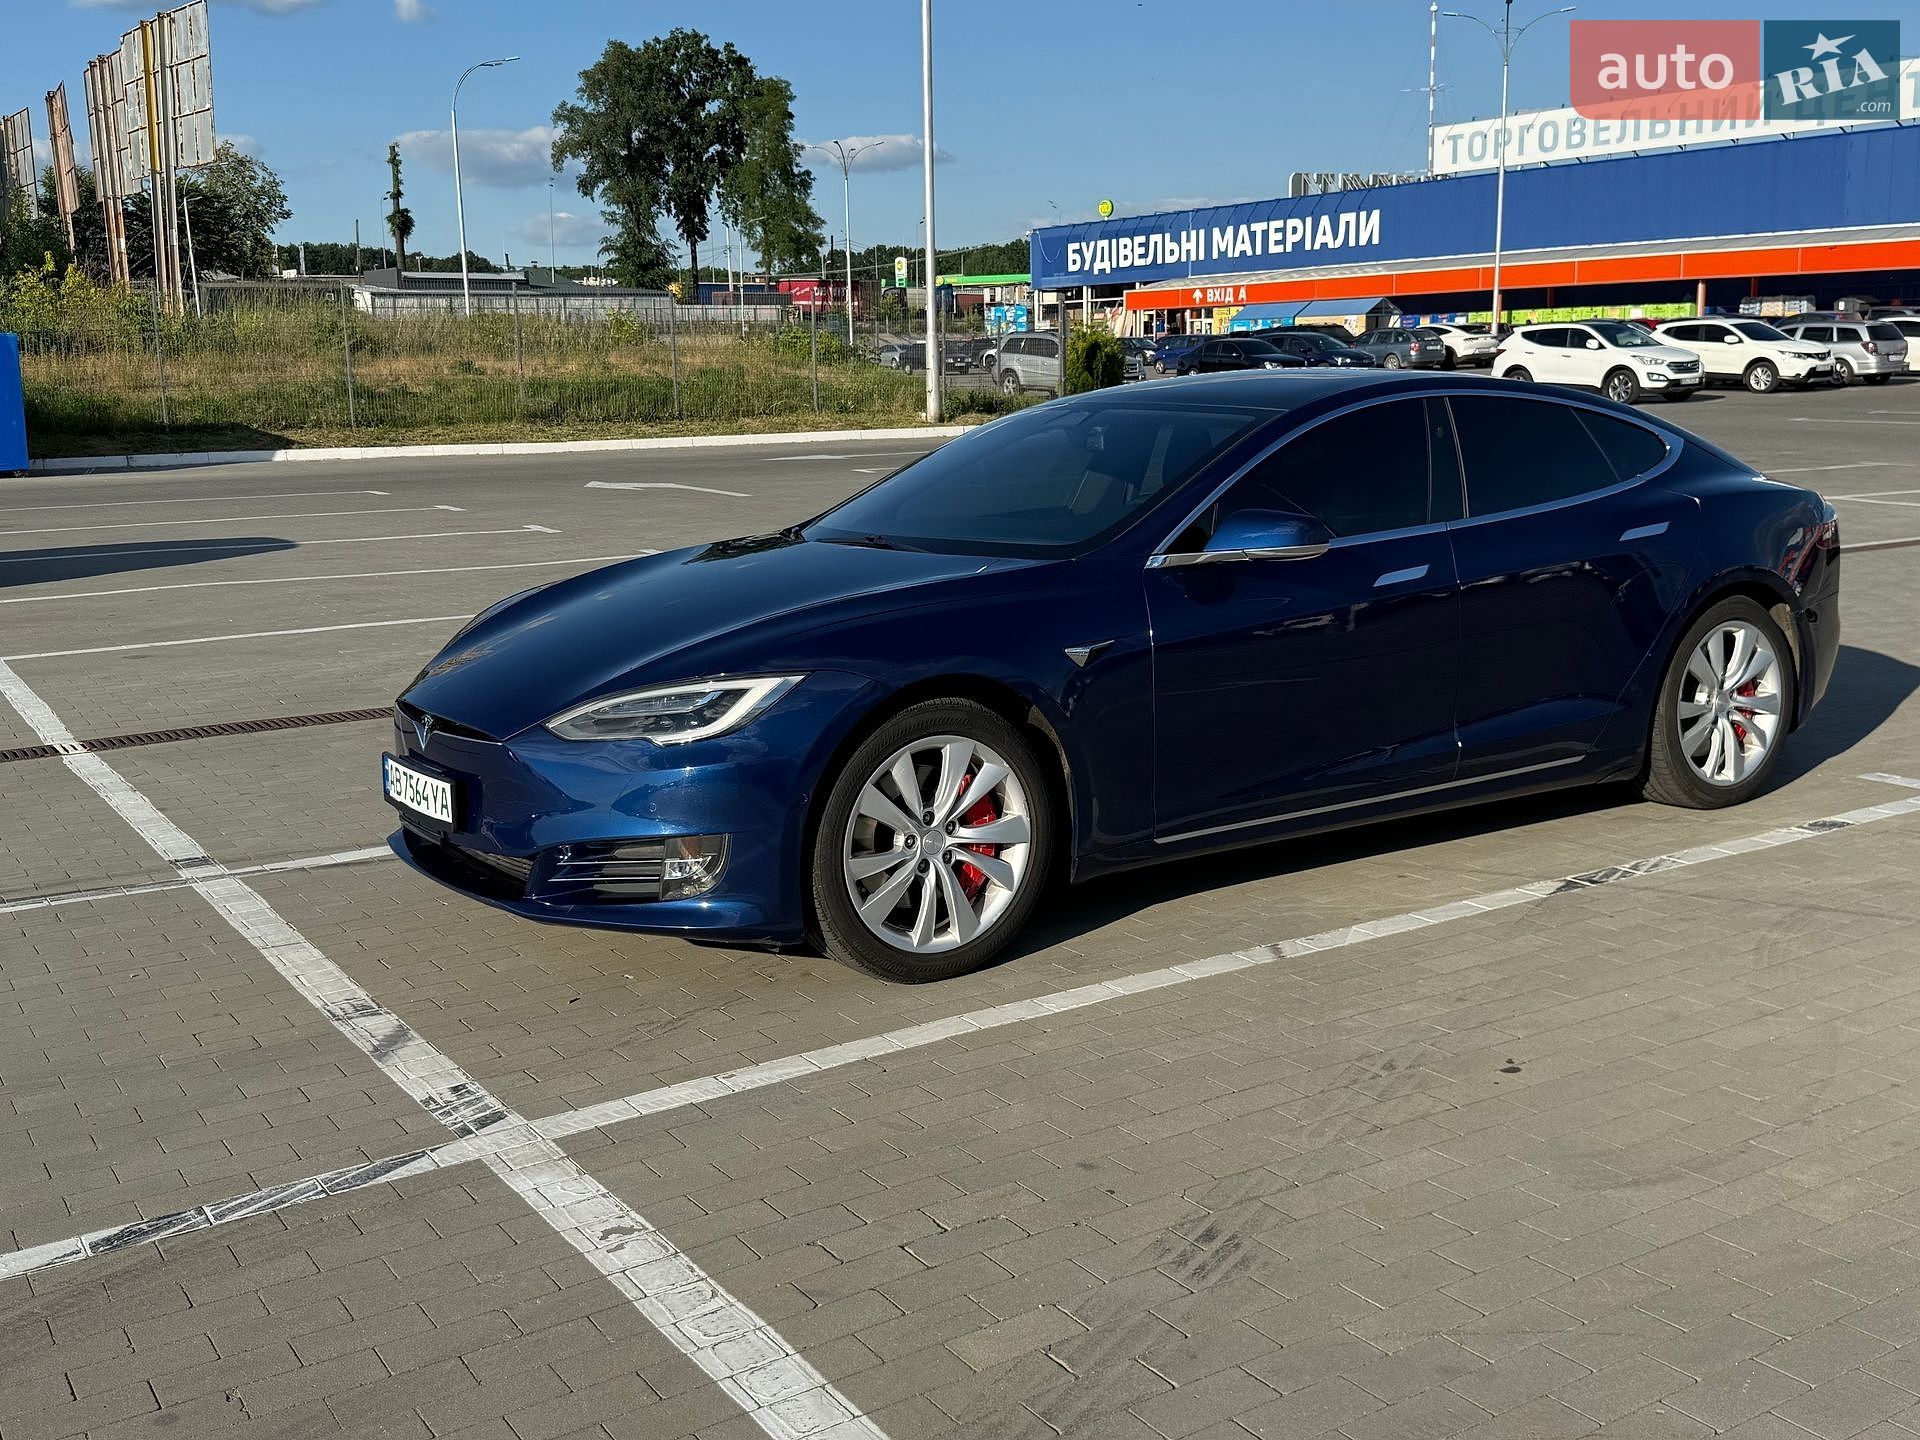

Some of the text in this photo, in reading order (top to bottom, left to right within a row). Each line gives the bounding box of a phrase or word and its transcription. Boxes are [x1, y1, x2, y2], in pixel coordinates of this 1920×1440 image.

[1067, 209, 1381, 275] БУДІВЕЛЬНІ МАТЕРІАЛИ
[1206, 287, 1234, 304] ВХІД
